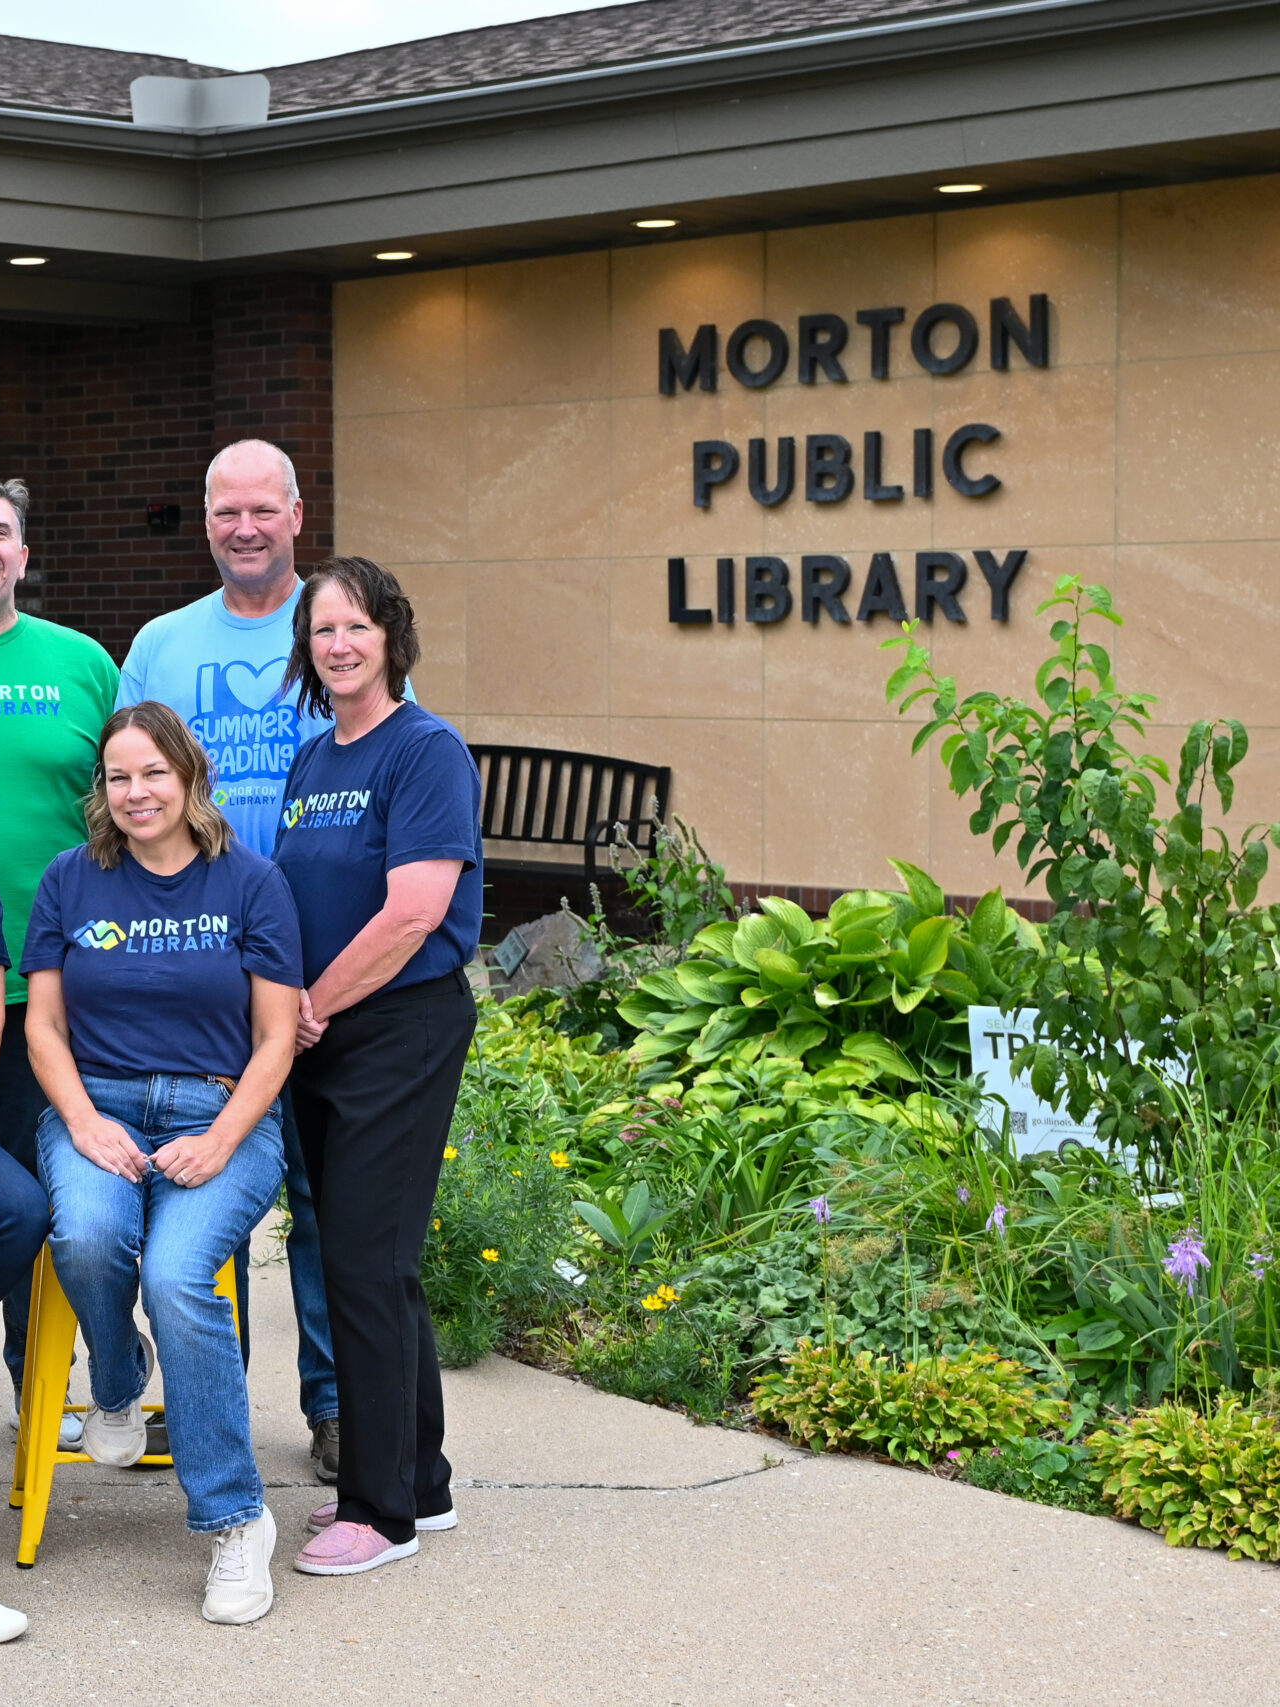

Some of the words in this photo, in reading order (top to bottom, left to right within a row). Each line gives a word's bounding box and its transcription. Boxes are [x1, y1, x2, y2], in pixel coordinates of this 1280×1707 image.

[658, 293, 1050, 395] MORTON
[693, 423, 1002, 508] PUBLIC
[668, 550, 1029, 625] LIBRARY
[228, 786, 277, 797] MORTON
[229, 796, 276, 806] LIBRARY
[305, 790, 371, 812] MORTON
[299, 809, 365, 828] LIBRARY
[129, 914, 228, 937] MORTON
[126, 933, 228, 953] LIBRARY
